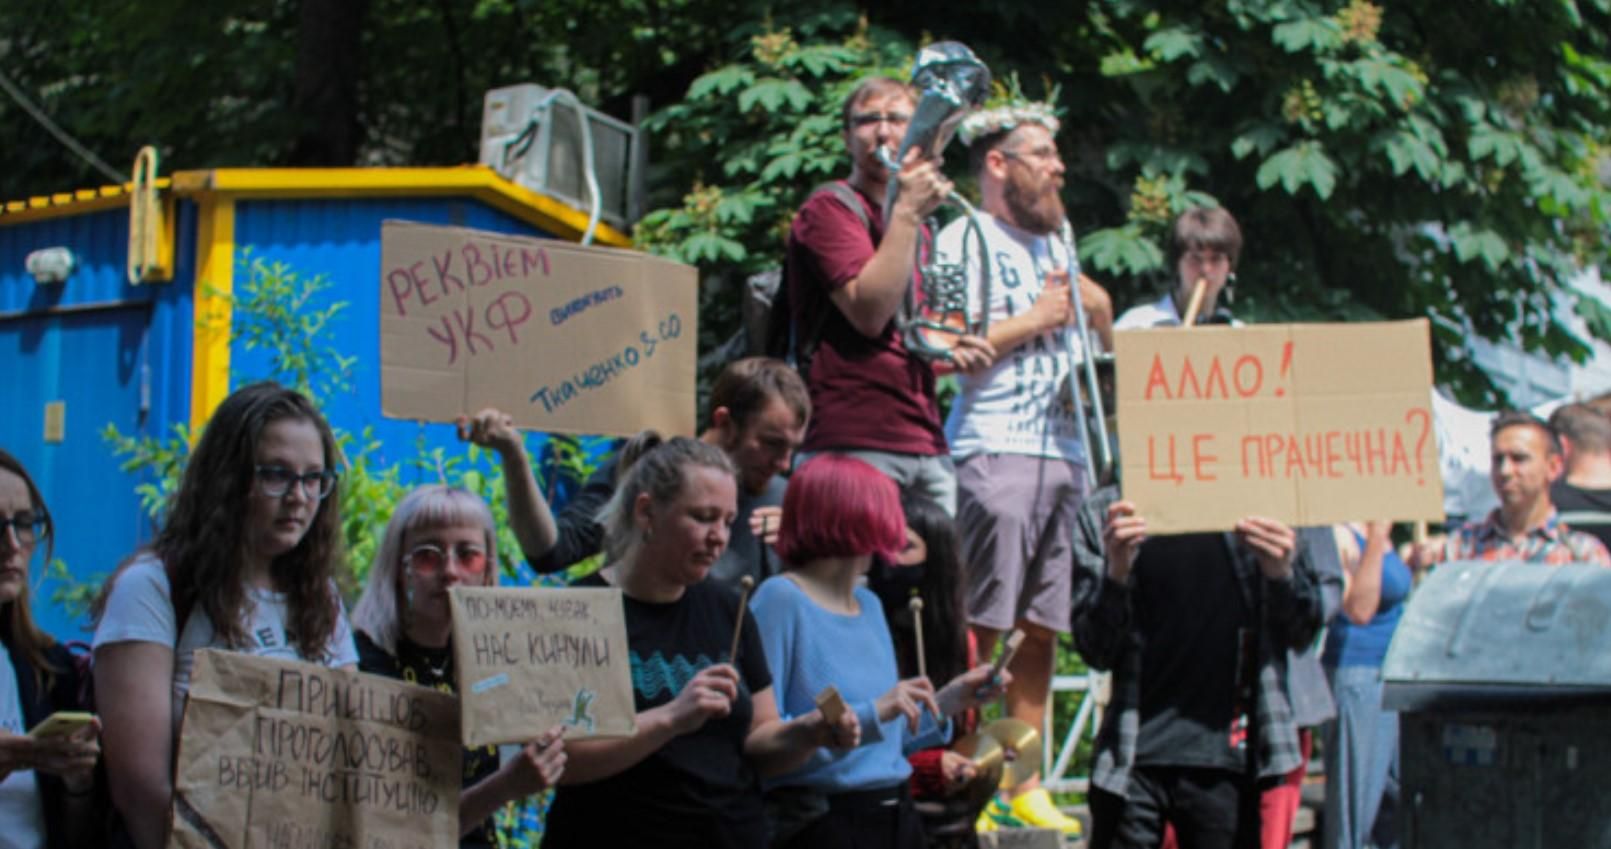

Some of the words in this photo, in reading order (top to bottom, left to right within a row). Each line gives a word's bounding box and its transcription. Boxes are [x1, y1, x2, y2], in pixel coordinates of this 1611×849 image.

[428, 291, 532, 365] УКФ
[1148, 434, 1218, 486] ЦЕ
[1241, 407, 1431, 487] ПРАЧЕЧНА?
[472, 632, 518, 666] НАС
[527, 631, 611, 668] КИНУЛИ
